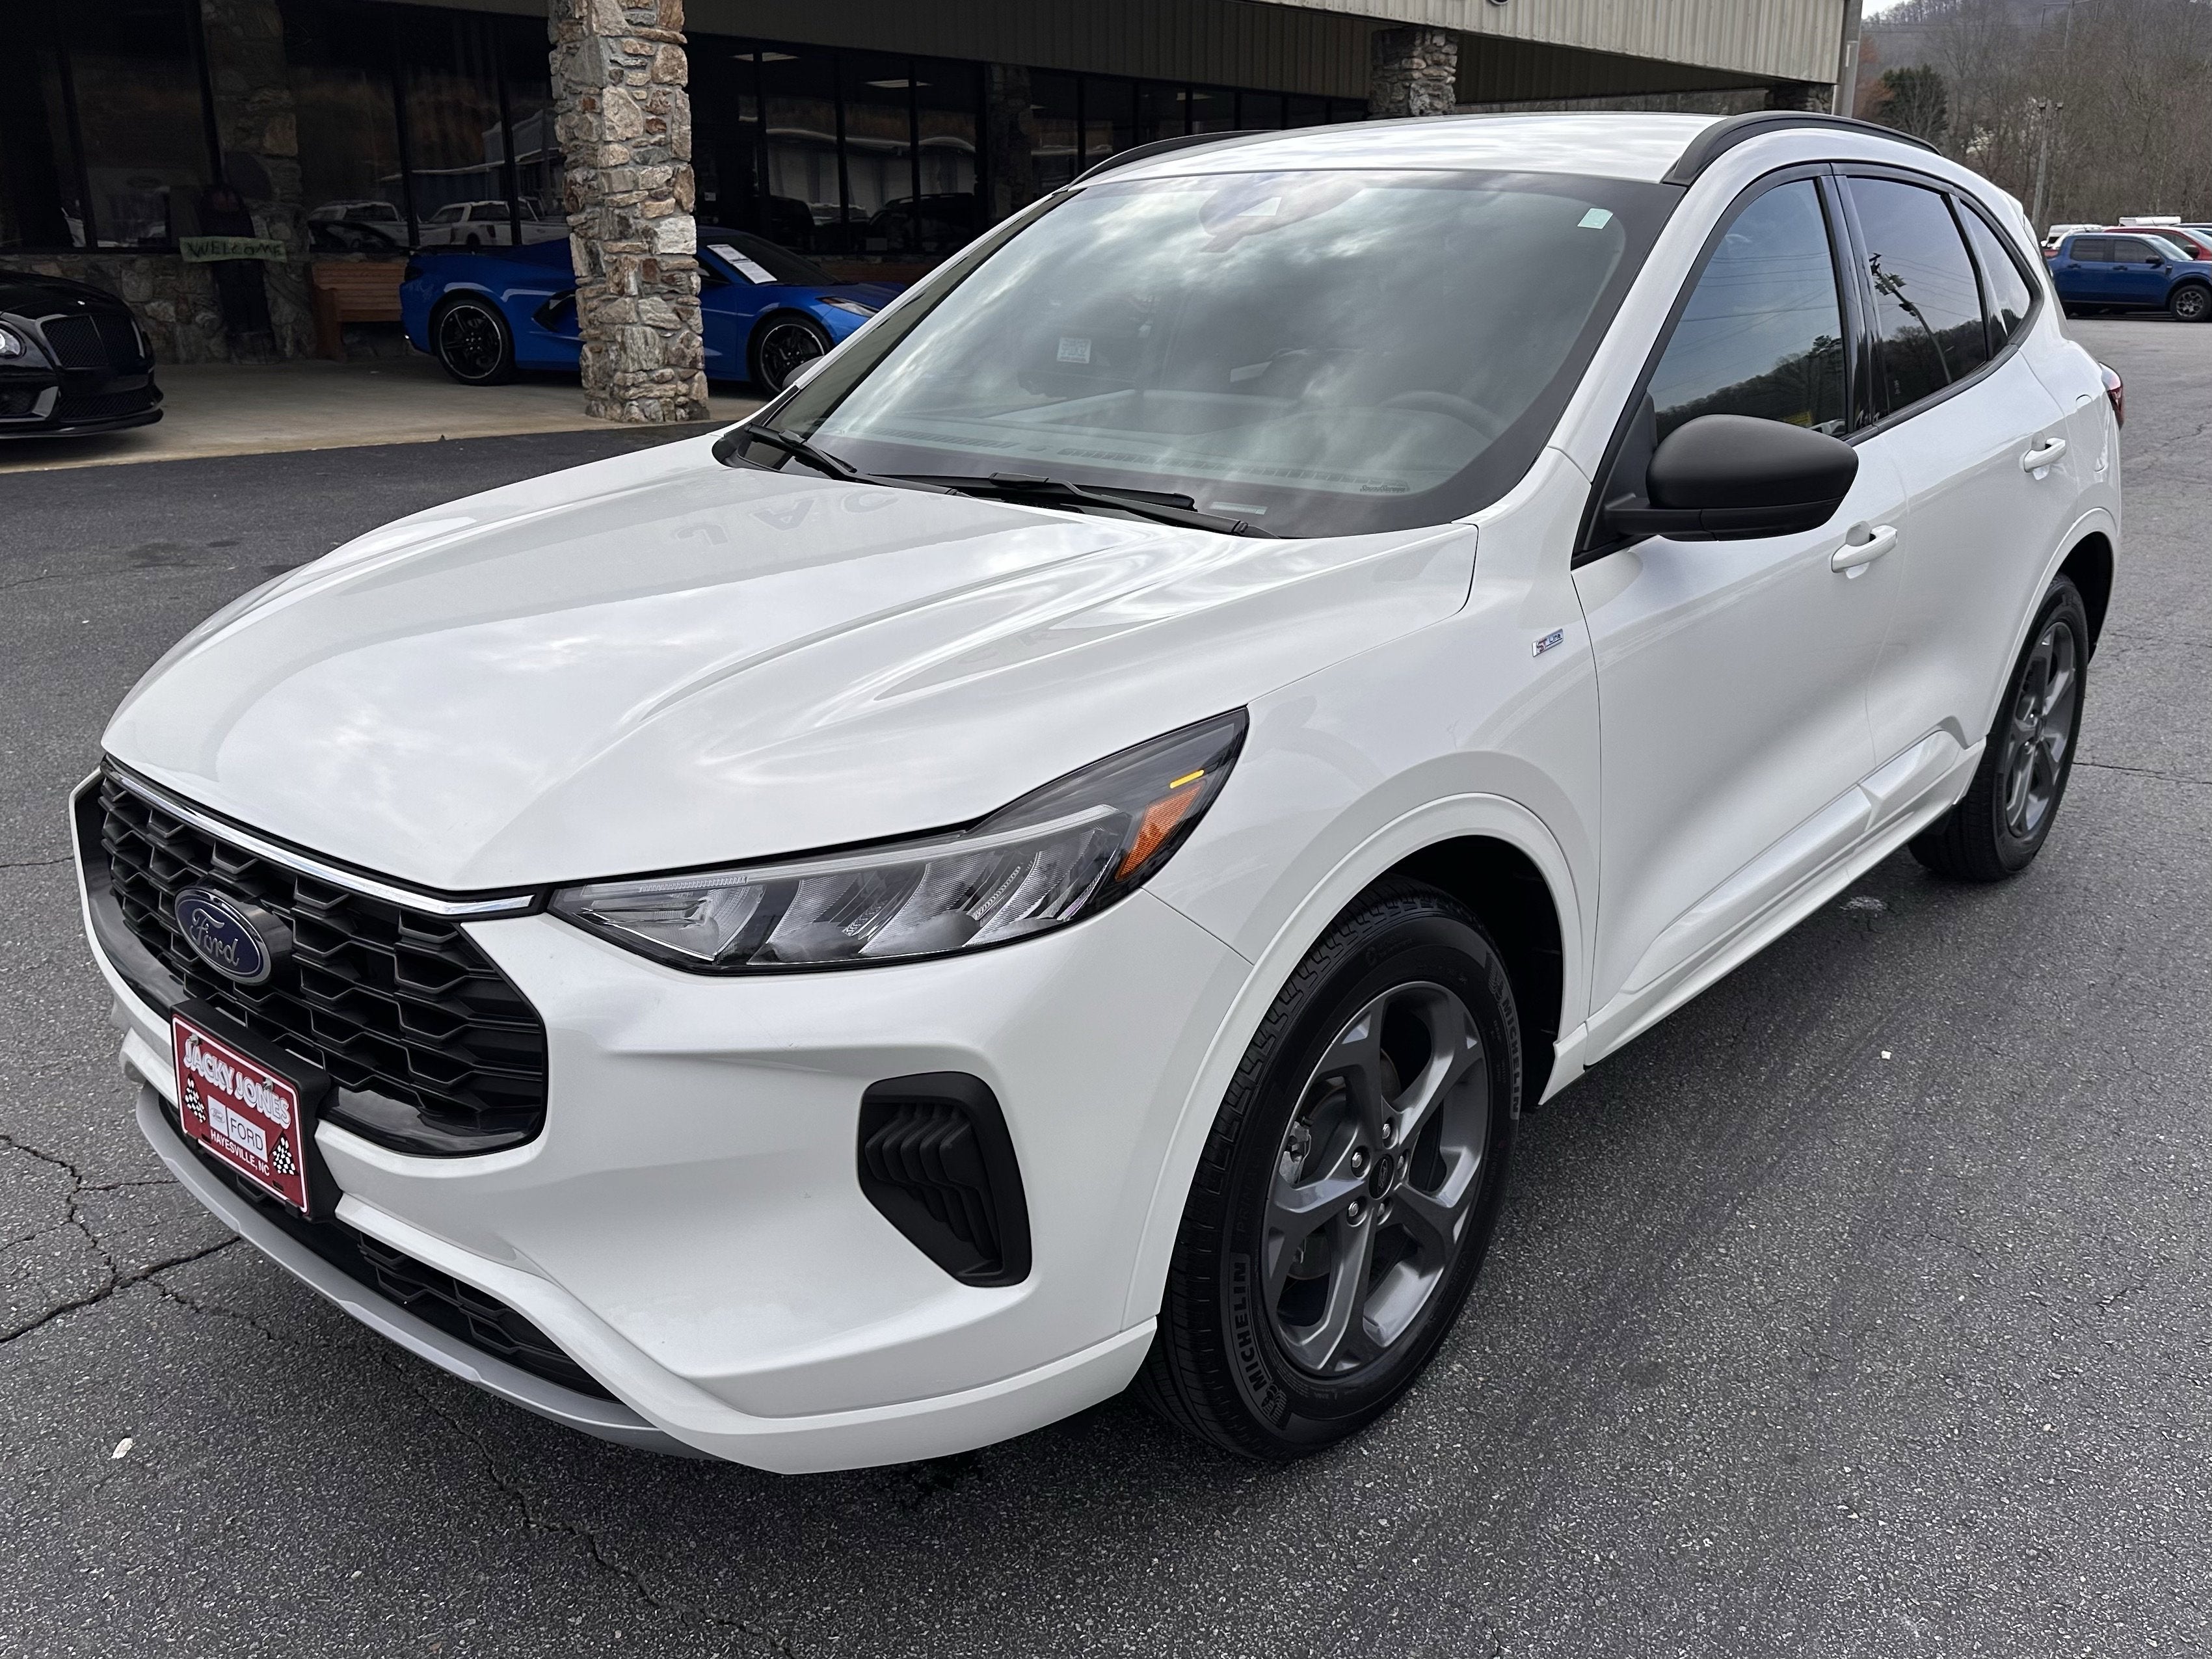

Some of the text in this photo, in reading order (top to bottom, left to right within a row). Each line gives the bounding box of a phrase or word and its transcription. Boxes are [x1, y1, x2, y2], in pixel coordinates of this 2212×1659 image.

[187, 240, 285, 258] WELCOME
[189, 908, 240, 967] Ford
[1501, 995, 1521, 1113] MICHELIN
[183, 1038, 291, 1130] JACKY JONES
[230, 1117, 263, 1151] FORD
[258, 1160, 270, 1176] NC
[1233, 1262, 1267, 1394] MICHELIN
